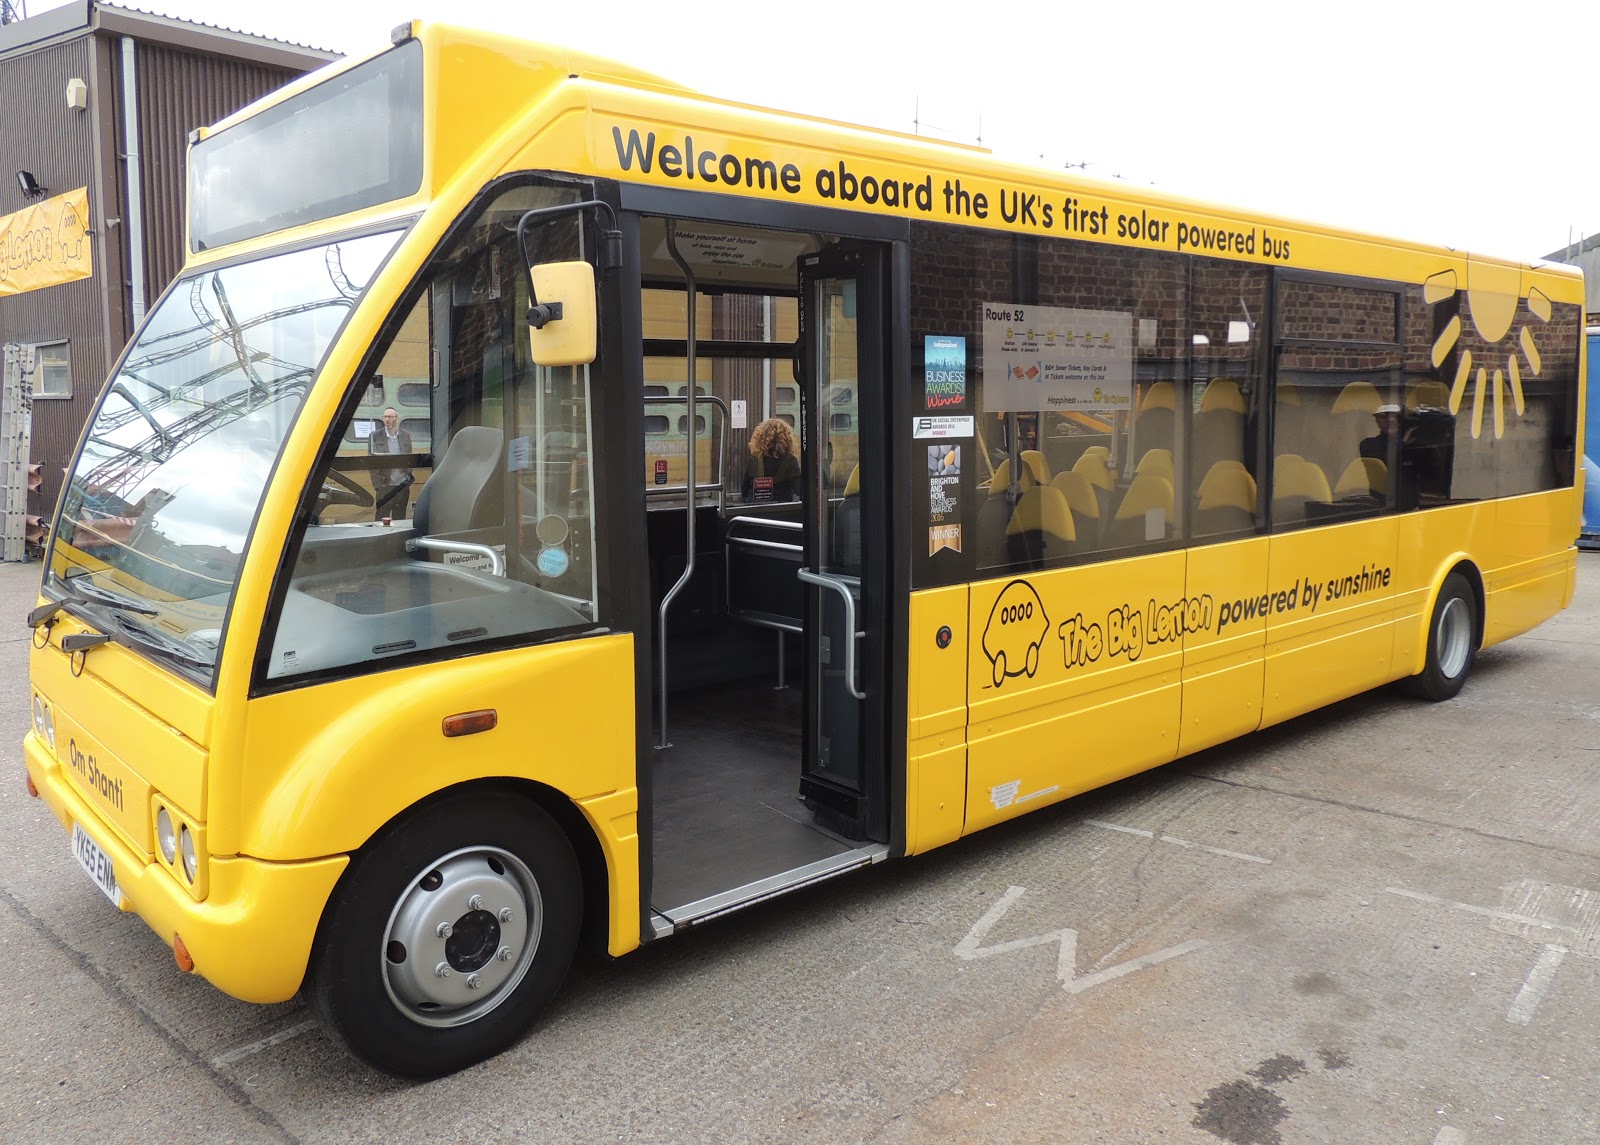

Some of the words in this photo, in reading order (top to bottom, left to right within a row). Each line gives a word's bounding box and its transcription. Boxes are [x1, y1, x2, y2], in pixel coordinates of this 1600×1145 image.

[613, 126, 801, 194] Welcome
[816, 160, 933, 212] aboard
[943, 179, 988, 220] the
[1000, 188, 1053, 229] UK's
[1062, 198, 1109, 236] first
[1117, 209, 1169, 243] solar
[1177, 221, 1255, 255] powered
[1262, 229, 1290, 260] bus
[696, 234, 726, 242] yourself
[8, 226, 52, 270] Lemon
[985, 308, 1011, 321] Route
[1013, 310, 1024, 321] 52
[926, 370, 965, 382] BUSINESS
[926, 382, 961, 394] AWARDS
[927, 393, 965, 408] Winner
[1047, 396, 1077, 406] Happiness
[930, 476, 959, 486] BRIGHTON
[930, 485, 943, 493] AND
[930, 492, 946, 500] HOVE
[930, 497, 957, 507] BUSINESS
[930, 505, 953, 514] AWARDS
[930, 527, 959, 541] WINNER
[1058, 612, 1103, 669] The
[1107, 603, 1144, 662] Big
[1146, 593, 1213, 646] Lemon
[1217, 579, 1300, 636] powered
[1301, 576, 1322, 613] by
[1325, 563, 1391, 602] sunshine
[70, 738, 86, 777] Om
[88, 754, 123, 813] Shanti
[76, 825, 97, 873] YK55
